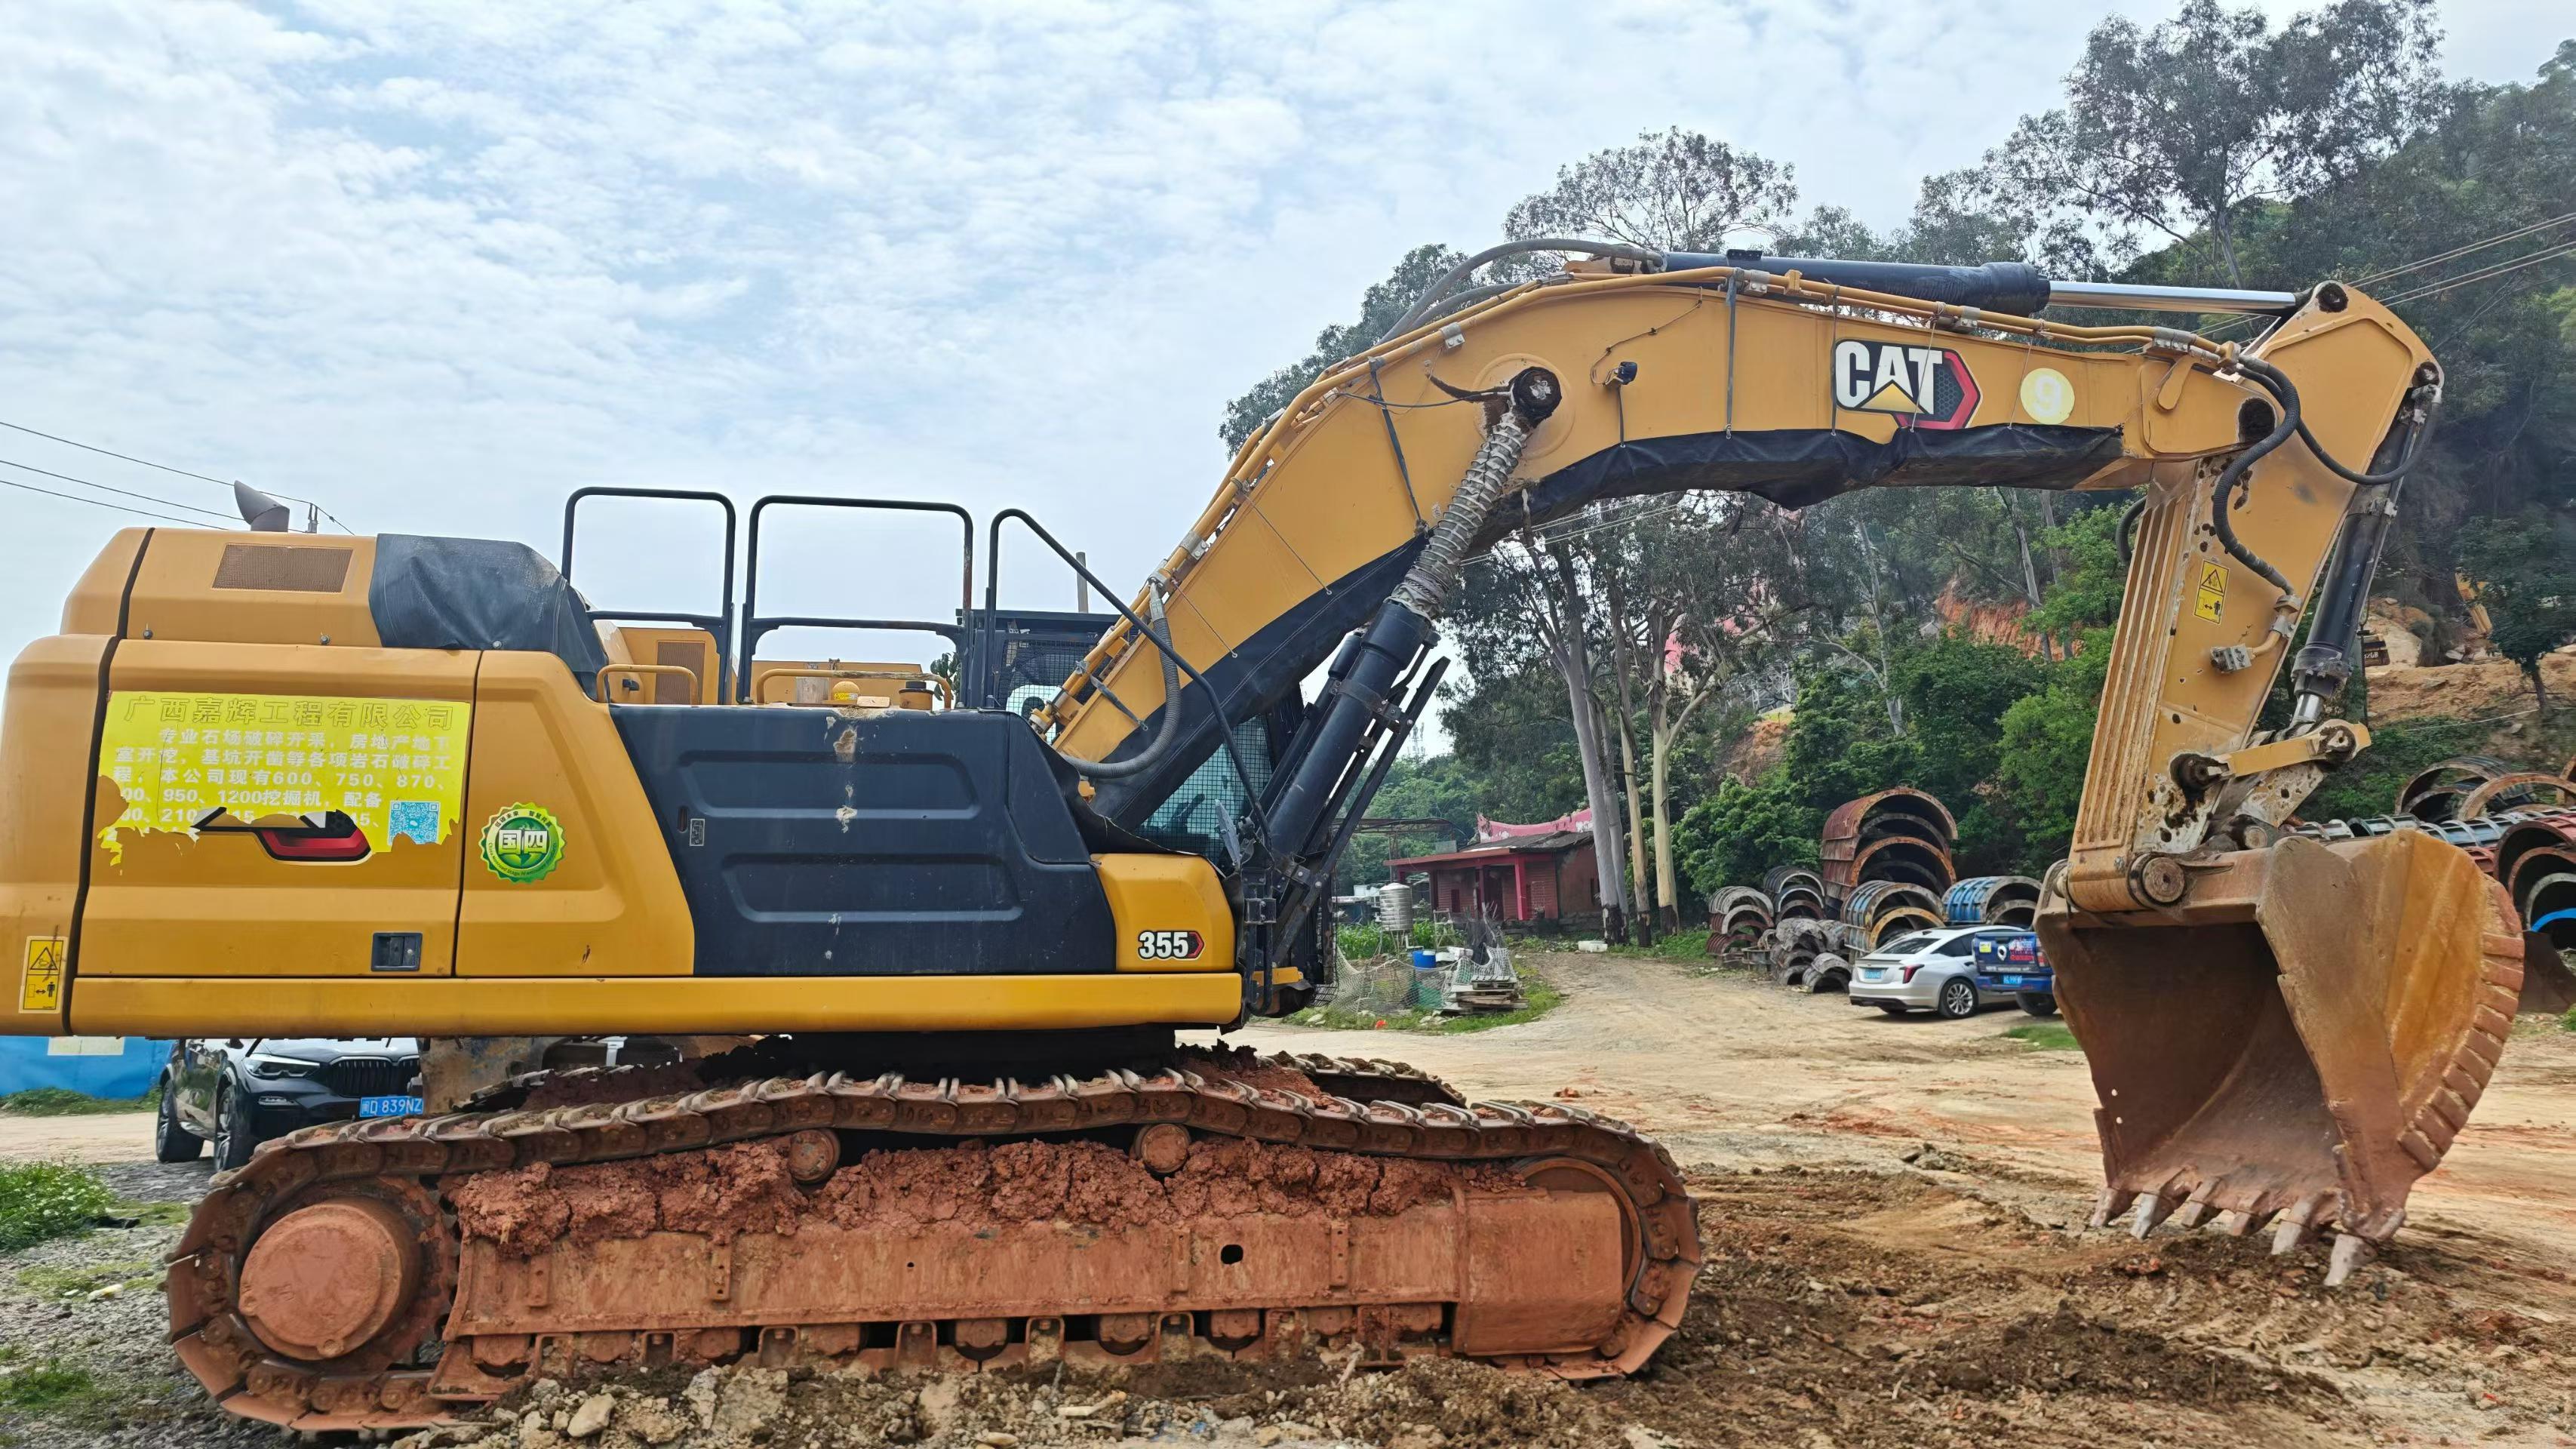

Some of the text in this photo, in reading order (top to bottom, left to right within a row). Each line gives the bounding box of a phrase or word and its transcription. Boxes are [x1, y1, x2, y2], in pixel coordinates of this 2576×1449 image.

[1835, 340, 1943, 415] CAT
[2033, 375, 2061, 417] 9
[124, 695, 453, 731] 广西嘉辉工程有限公司
[503, 832, 543, 849] 国四
[1139, 931, 1189, 958] 355
